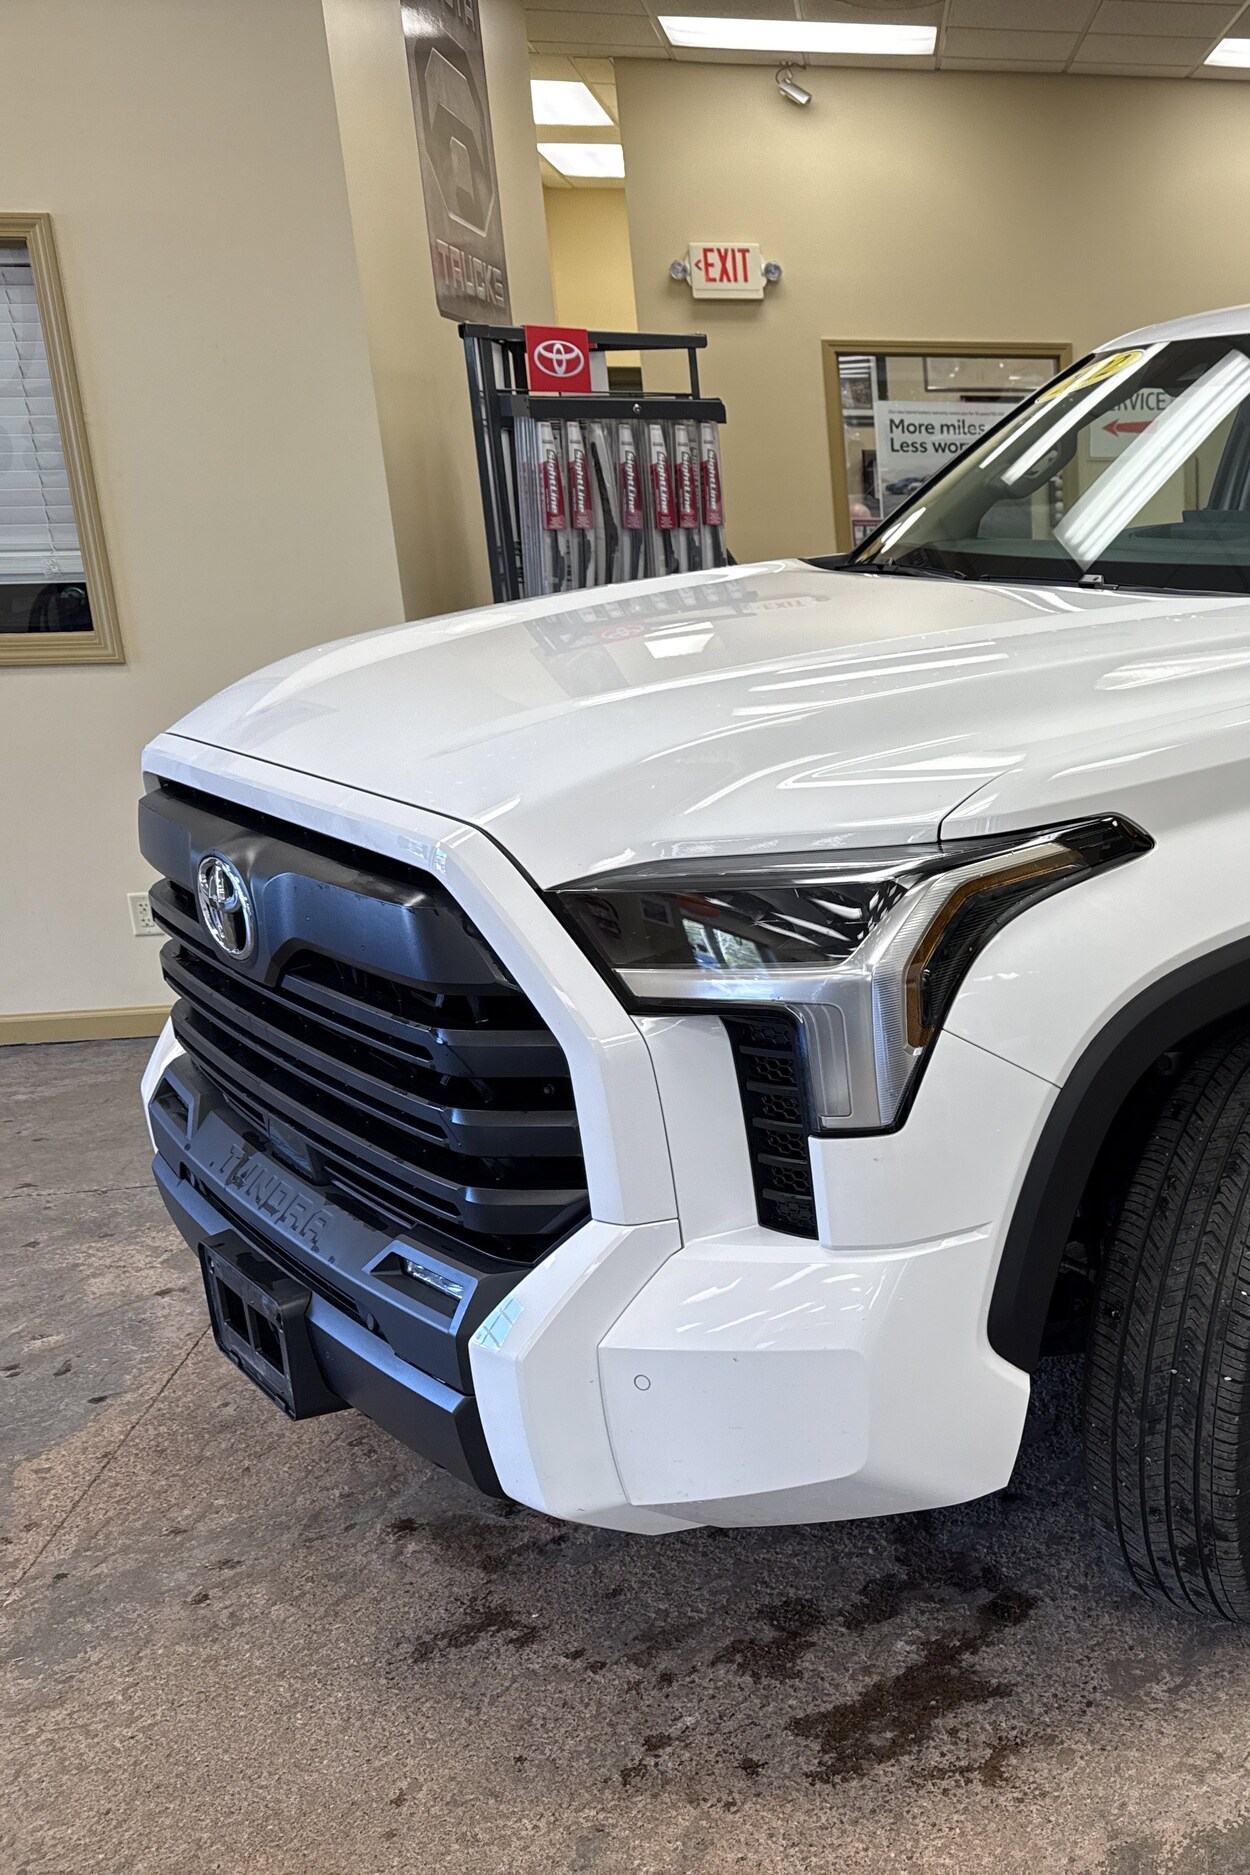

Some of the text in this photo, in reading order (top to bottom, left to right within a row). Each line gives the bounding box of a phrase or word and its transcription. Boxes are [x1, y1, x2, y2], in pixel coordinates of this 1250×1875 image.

[436, 239, 505, 307] TRUCKS
[702, 247, 750, 283] EXIT
[889, 418, 986, 435] More miles
[1110, 392, 1167, 411] VICE
[890, 437, 970, 454] Less wor
[547, 450, 558, 514] SightLine
[575, 450, 585, 513] SightLine
[625, 452, 636, 513] SightLine
[657, 453, 669, 513] SightLine
[682, 453, 691, 513] SightLine
[708, 450, 717, 509] SightLine
[218, 1144, 334, 1244] TUNDRA
